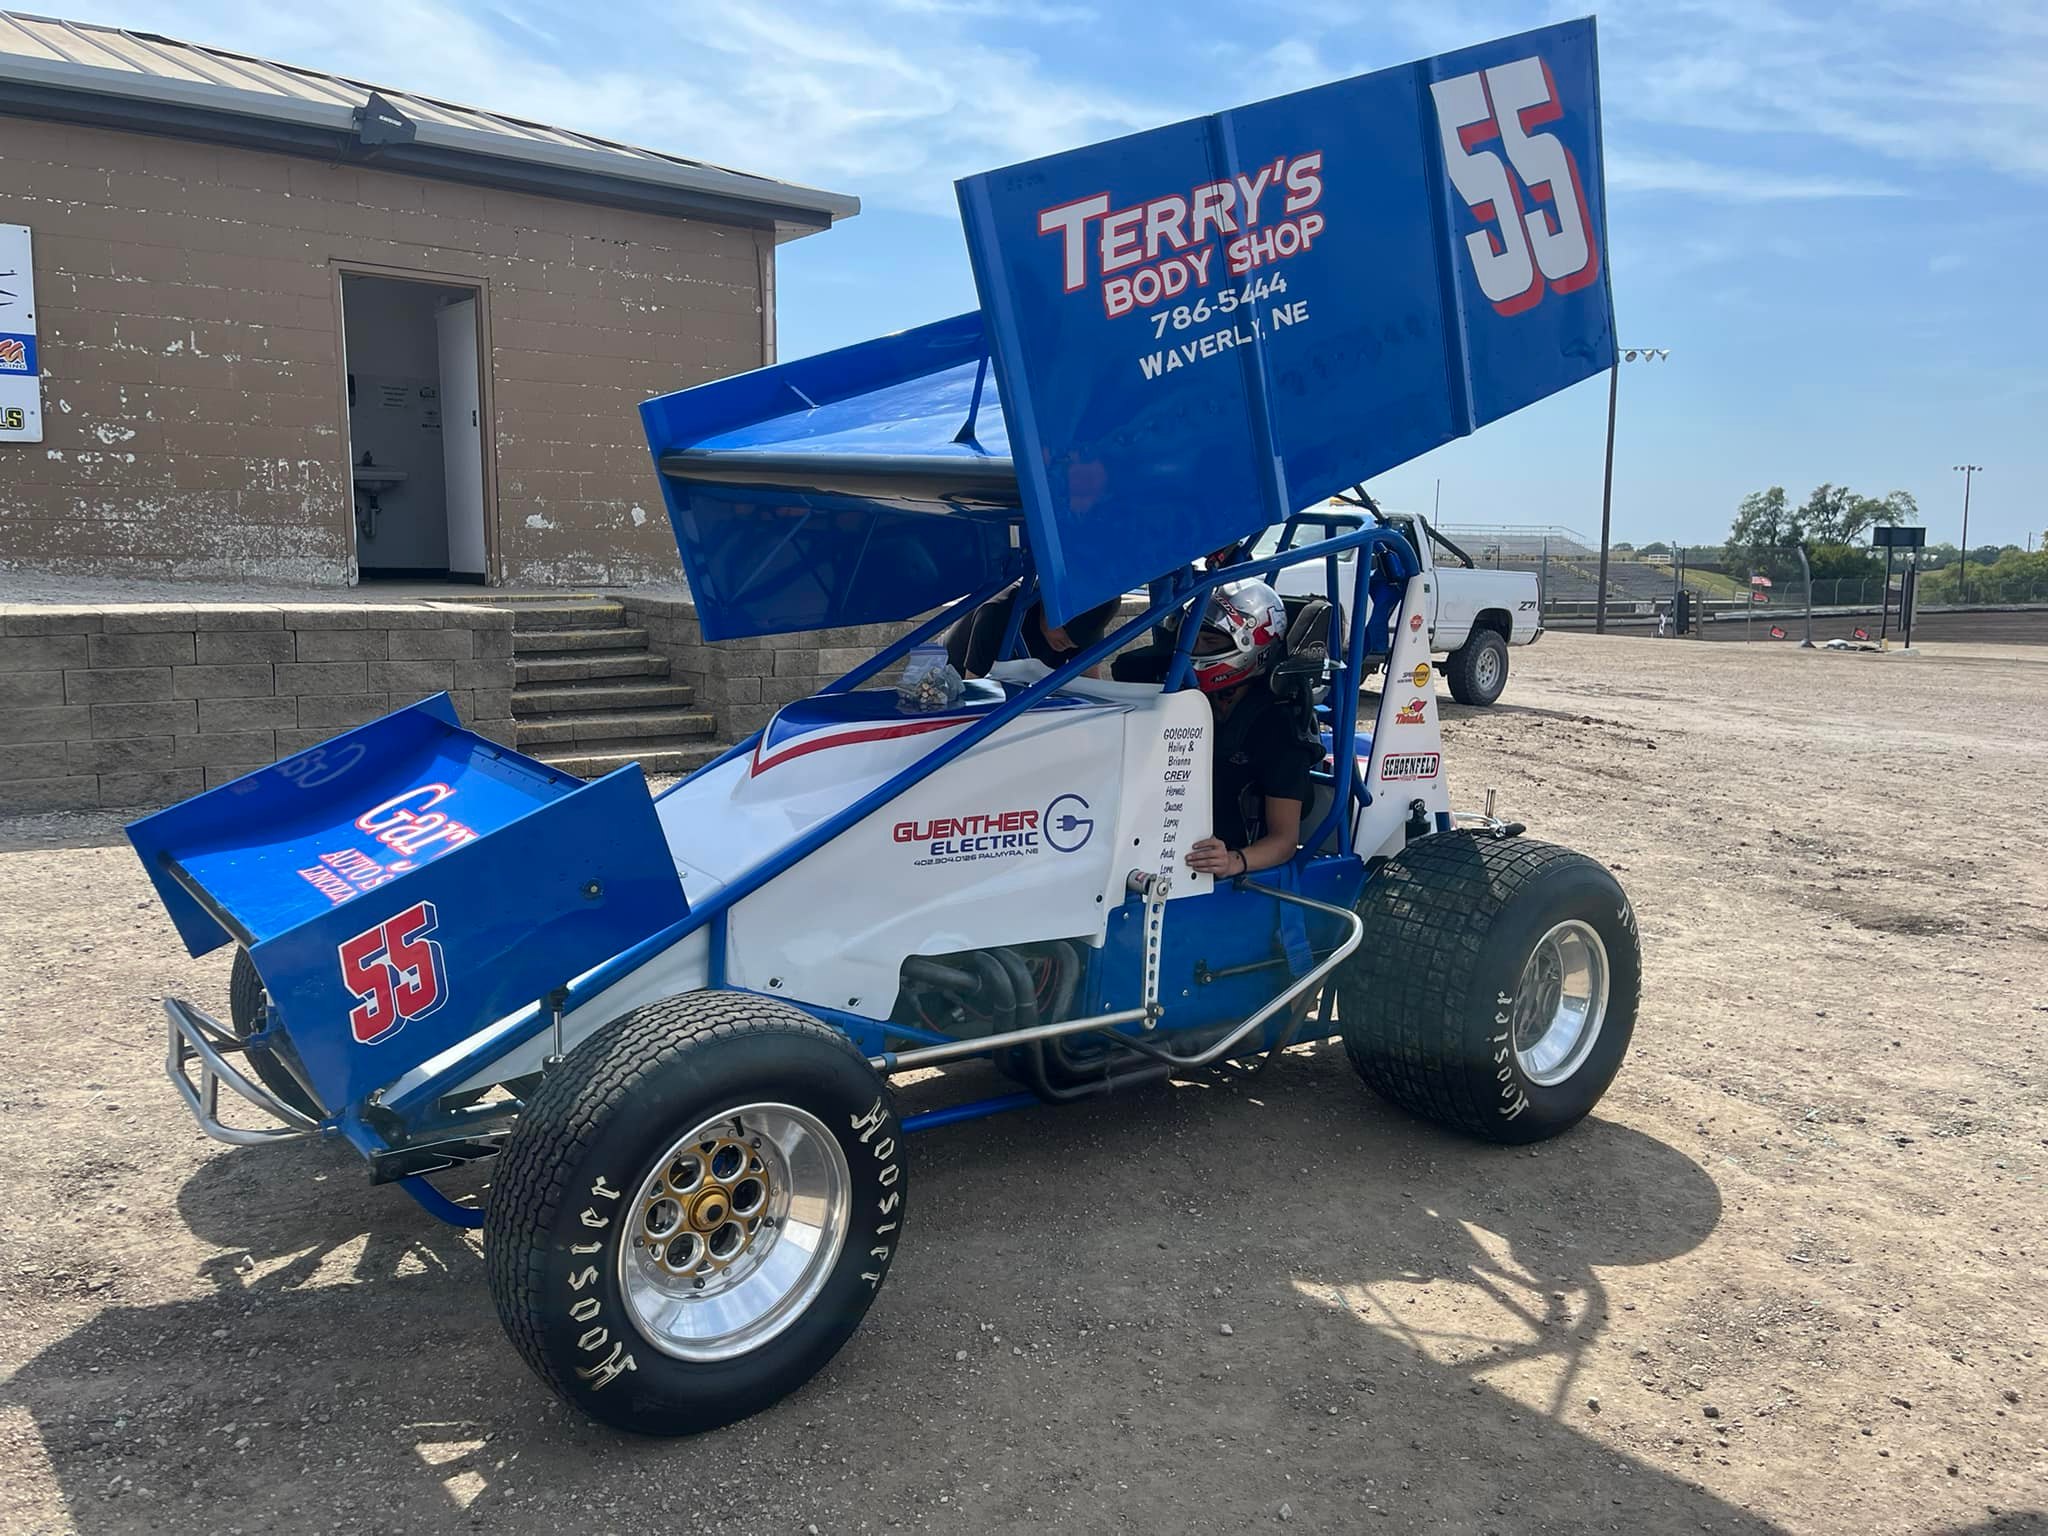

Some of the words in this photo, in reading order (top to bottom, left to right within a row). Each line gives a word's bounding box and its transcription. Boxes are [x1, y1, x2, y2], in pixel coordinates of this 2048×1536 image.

[1429, 55, 1598, 317] 55
[1102, 245, 1214, 319] BODY
[1227, 213, 1325, 275] SHOP
[1150, 271, 1288, 339] 786-5444
[1271, 300, 1311, 331] NE
[1518, 600, 1537, 611] Z71
[1187, 740, 1195, 752] &
[1163, 770, 1192, 781] CREW
[1384, 756, 1437, 776] SCHOENFELD
[893, 809, 1039, 844] GUENTHER
[930, 832, 1039, 856] ELECTRIC
[979, 849, 1024, 861] PALMYRA,
[317, 847, 384, 881] AUTO
[337, 899, 450, 1046] 55
